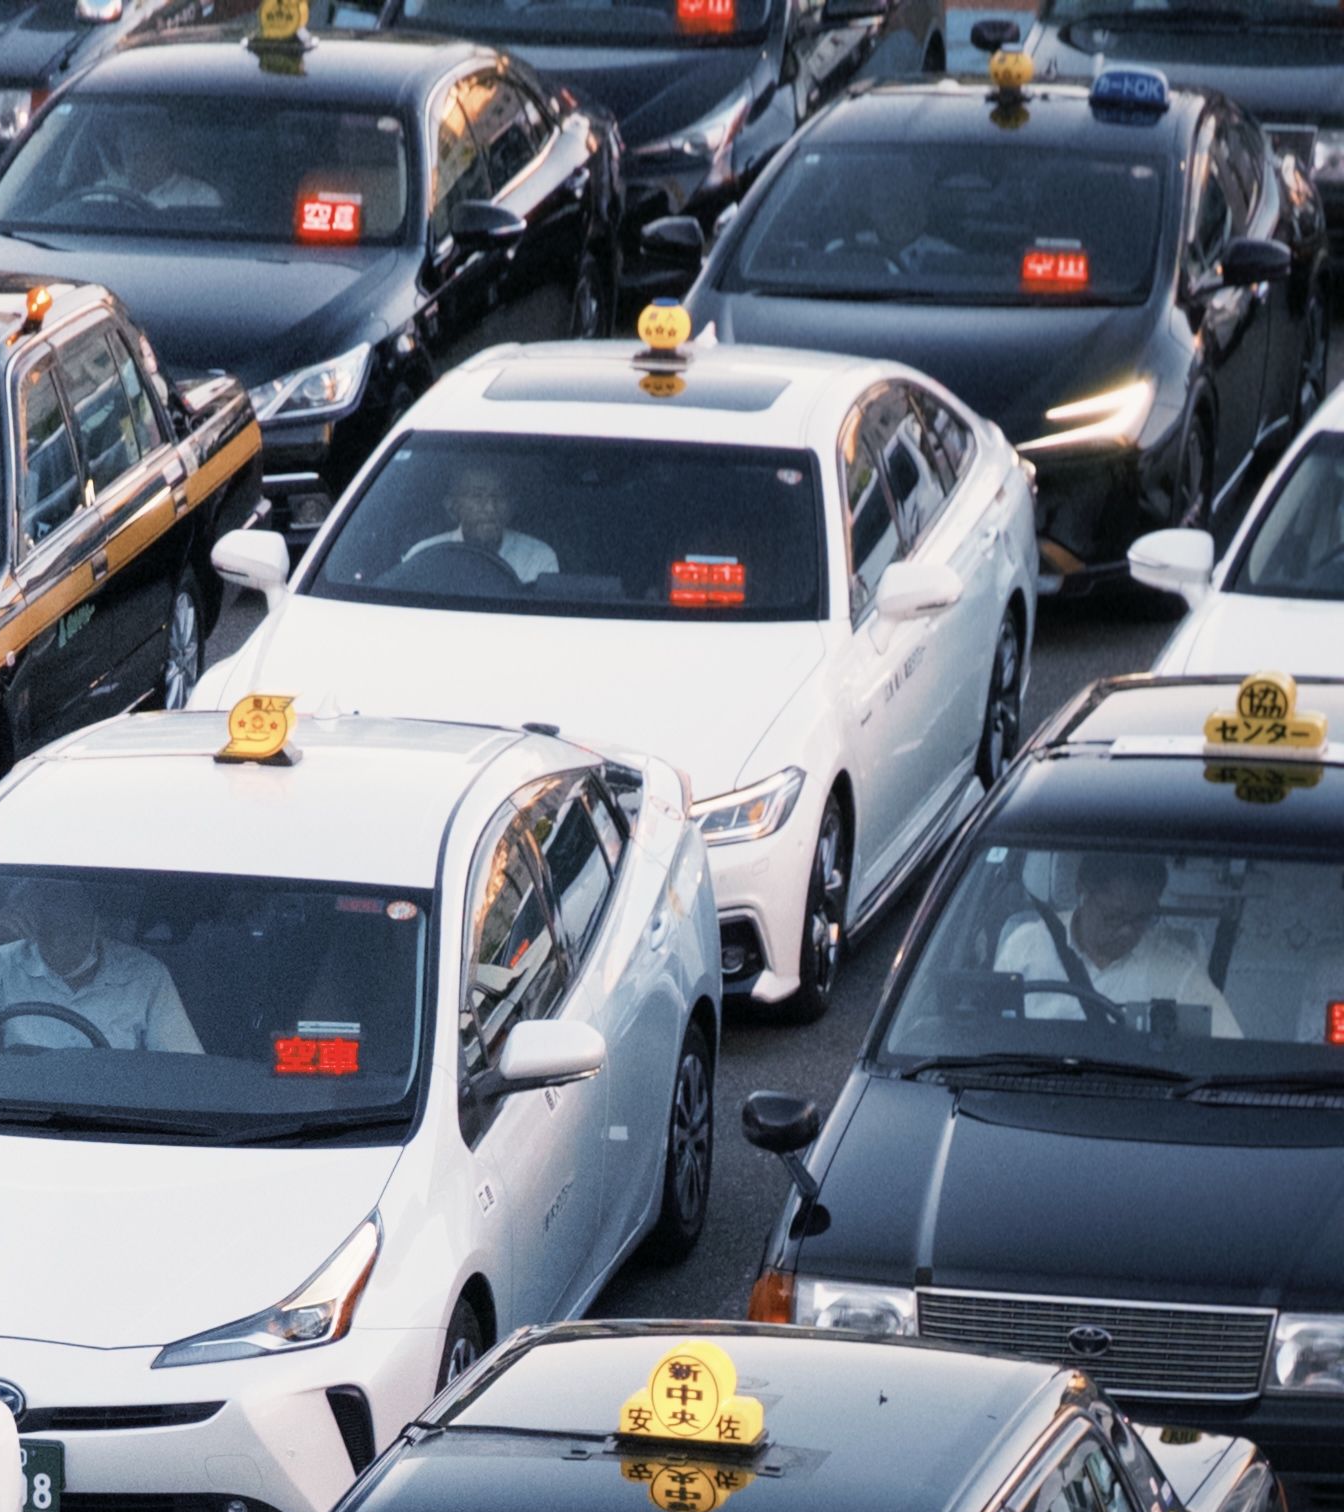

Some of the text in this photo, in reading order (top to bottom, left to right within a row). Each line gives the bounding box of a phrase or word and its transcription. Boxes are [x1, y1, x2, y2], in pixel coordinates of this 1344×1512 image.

[1243, 684, 1282, 719] 協
[1215, 720, 1311, 744] センター
[667, 1361, 703, 1430] 新中央
[628, 1408, 741, 1440] 安 佐
